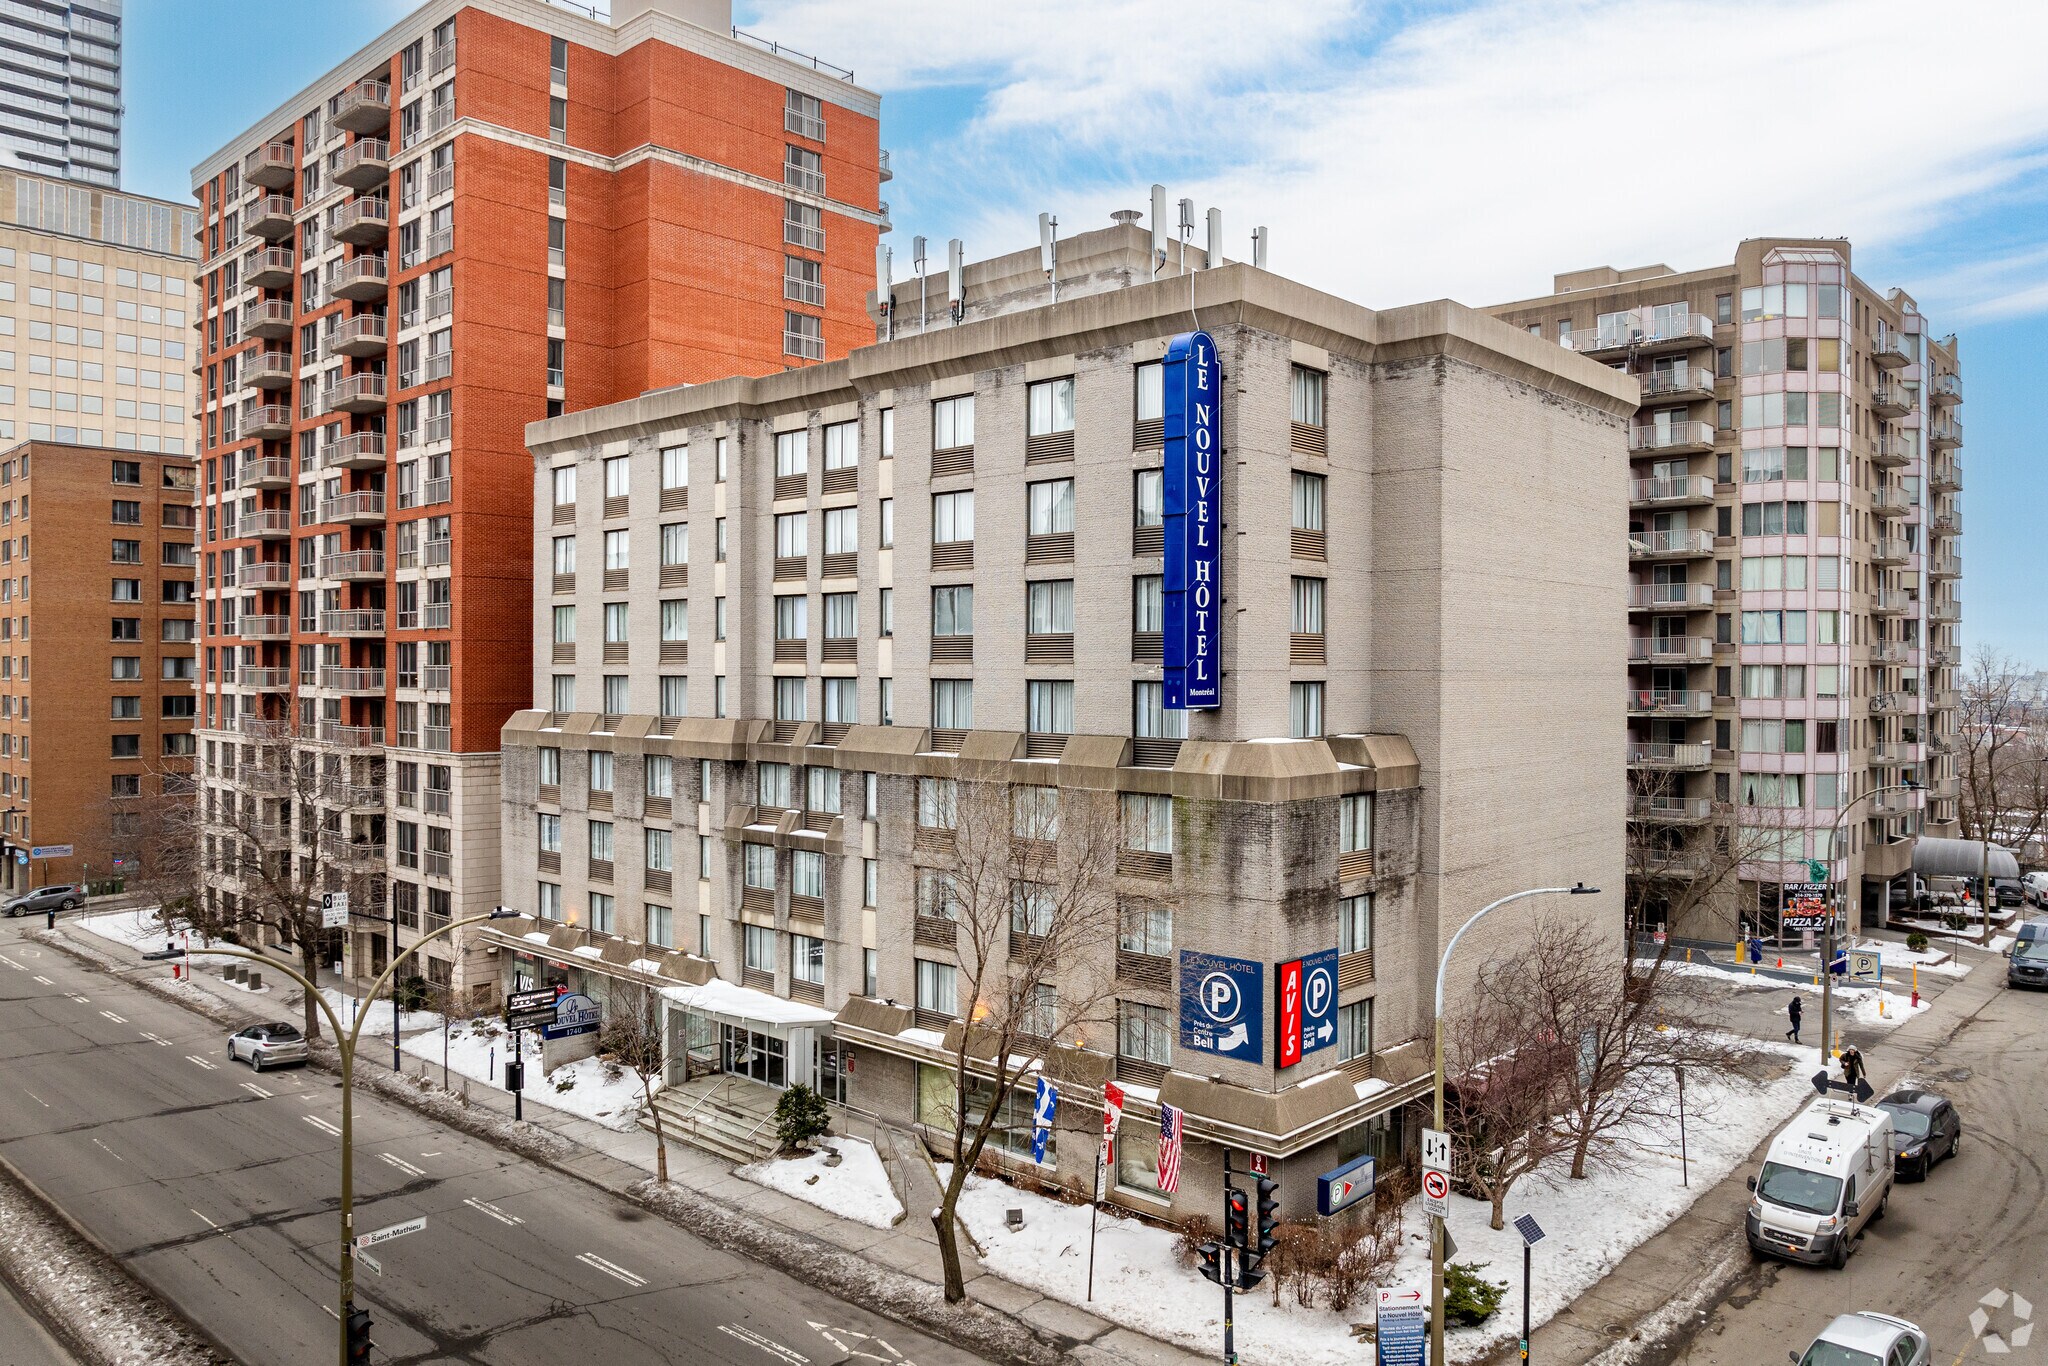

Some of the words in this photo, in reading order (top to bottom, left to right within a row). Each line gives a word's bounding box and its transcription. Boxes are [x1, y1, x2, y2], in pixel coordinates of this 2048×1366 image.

[1197, 344, 1209, 391] LE
[1196, 402, 1211, 548] NOUVEL
[1195, 559, 1211, 681] HÔTEL
[1189, 688, 1215, 696] Montréal
[1783, 917, 1812, 927] PIZZA
[1196, 957, 1228, 971] NOUVEL
[1229, 960, 1256, 974] HÔTEL
[1306, 958, 1323, 967] NOUVEL
[1323, 953, 1337, 964] HÔTEL
[1211, 981, 1231, 1013] P
[1312, 977, 1326, 1010] P
[1286, 970, 1297, 1056] AVIS
[1193, 1019, 1206, 1028] Près
[566, 1026, 582, 1036] 1740
[1193, 1026, 1213, 1037] Centre
[1303, 1030, 1315, 1039] Centre
[1193, 1035, 1213, 1049] Bell
[1303, 1037, 1315, 1050] Bell
[371, 1223, 421, 1243] Saint-Mathieu
[1773, 1232, 1797, 1242] RAM
[1382, 1292, 1389, 1302] P
